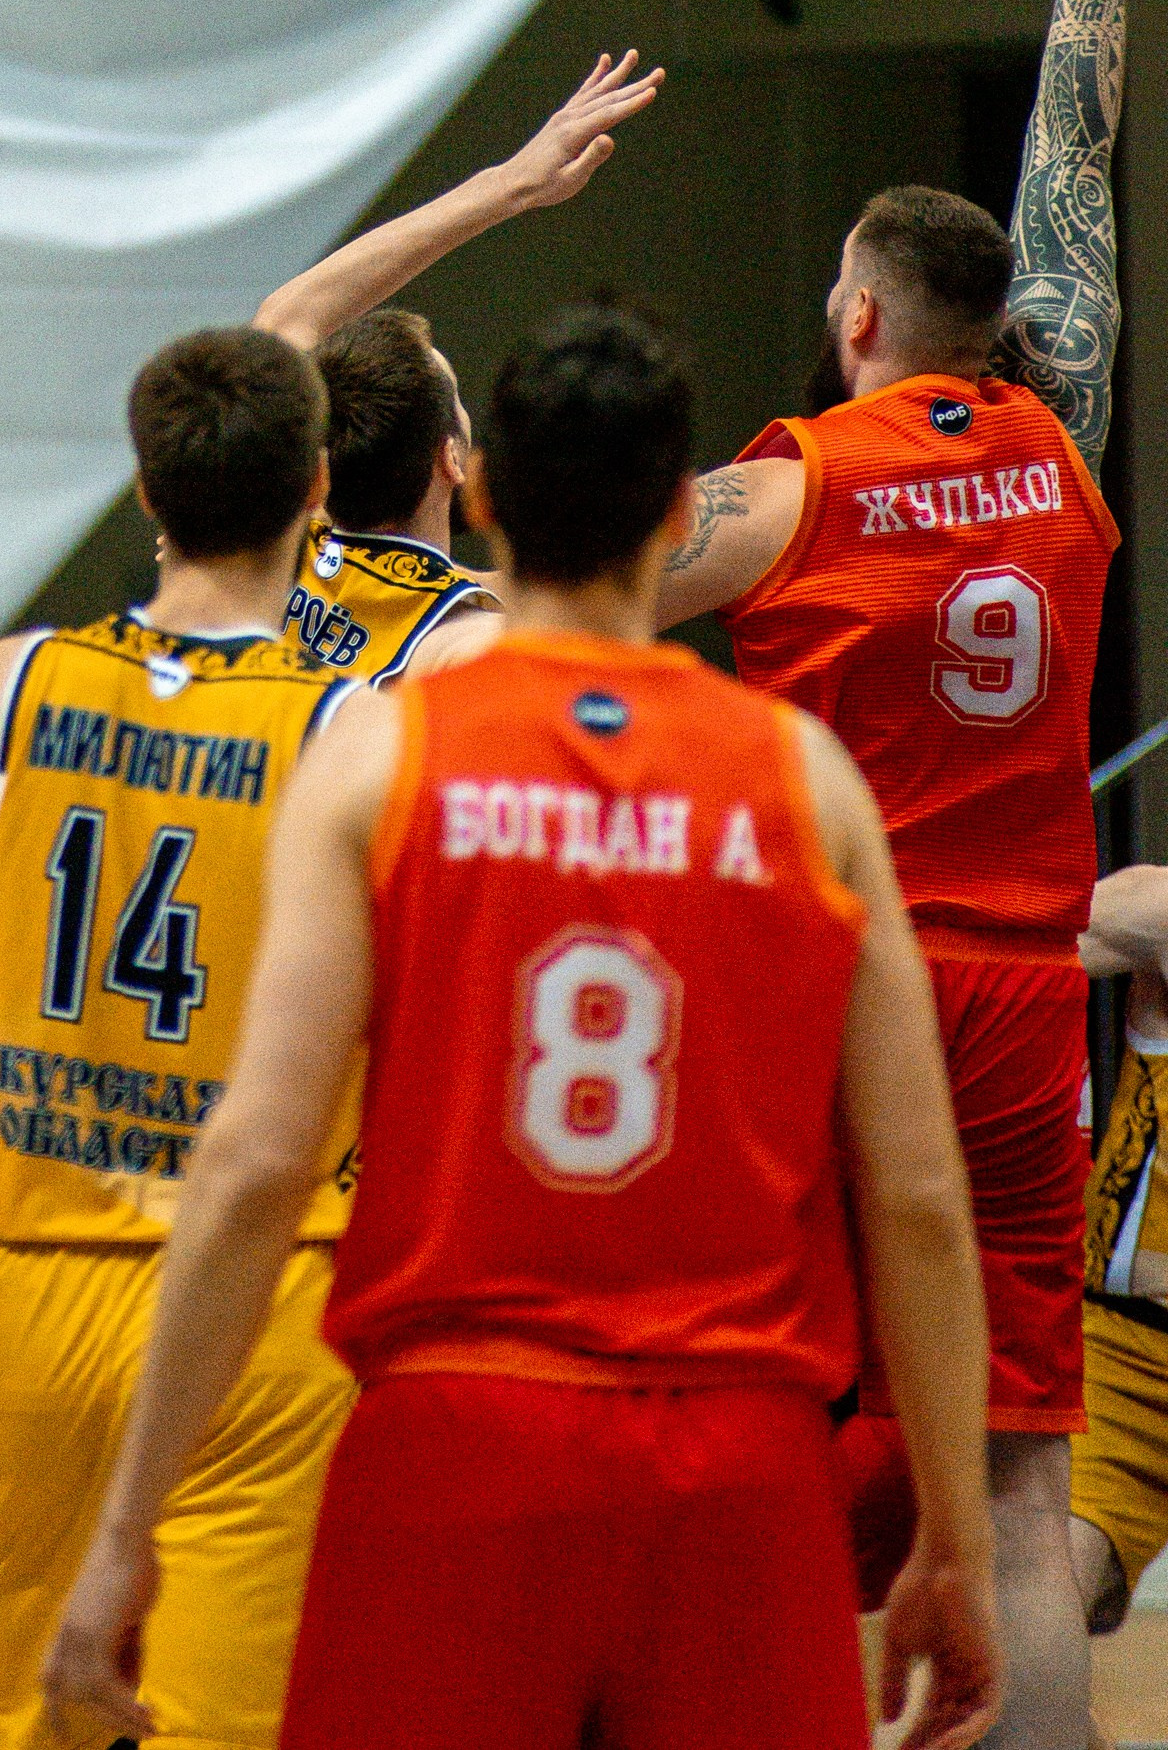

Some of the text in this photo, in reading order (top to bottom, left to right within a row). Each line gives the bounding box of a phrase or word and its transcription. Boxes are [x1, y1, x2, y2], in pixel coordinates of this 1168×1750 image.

[936, 405, 967, 425] РФБ
[932, 565, 1051, 727] 9
[29, 702, 269, 806] МИЛЮТИН
[441, 780, 692, 877] БОГДАН
[40, 805, 206, 1043] 14
[506, 930, 680, 1188] 8
